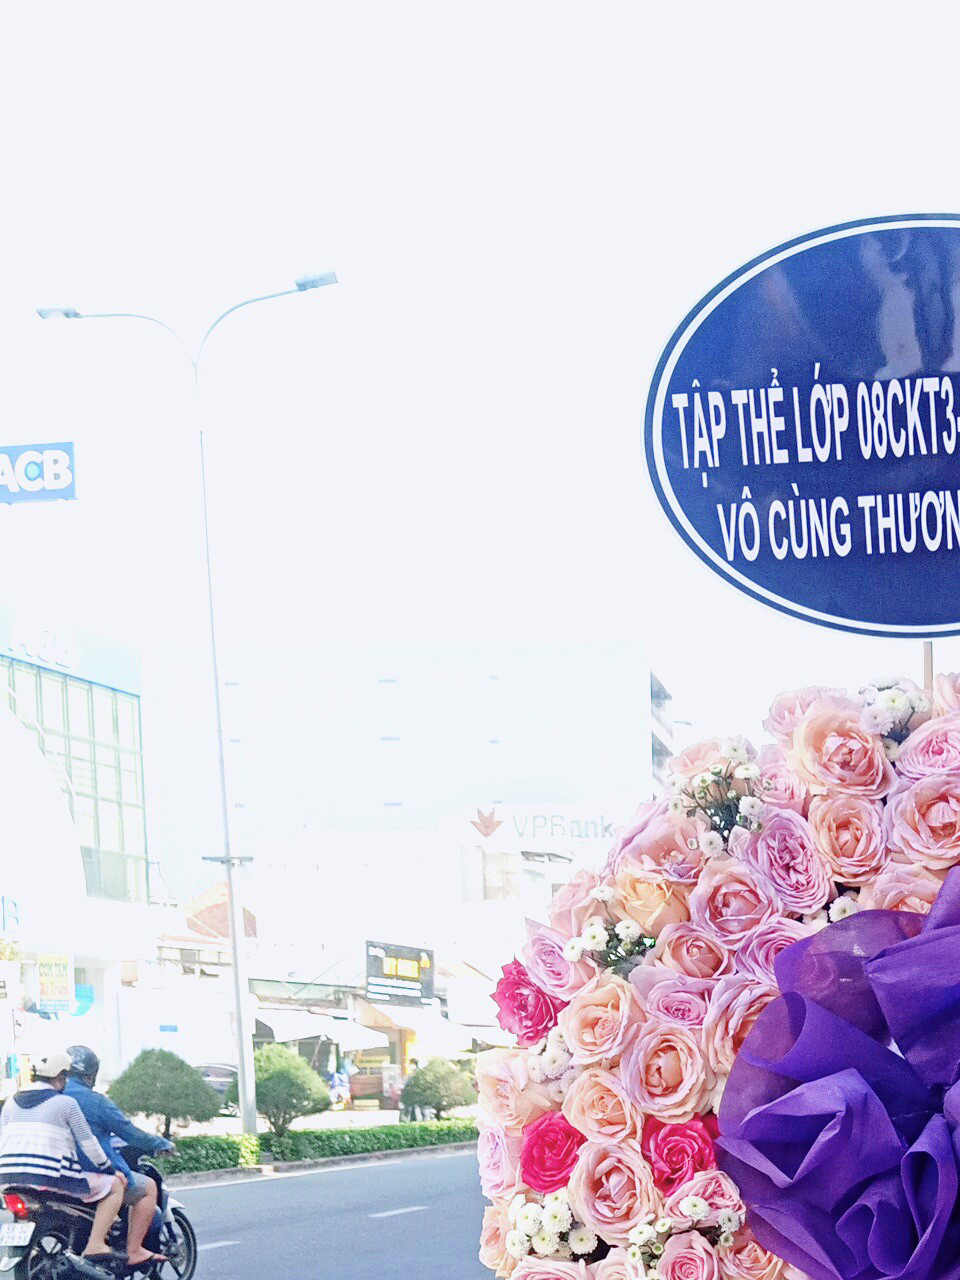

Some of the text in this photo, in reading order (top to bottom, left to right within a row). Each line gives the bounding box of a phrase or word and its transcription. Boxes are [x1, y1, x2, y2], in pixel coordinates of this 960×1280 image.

[671, 380, 727, 488] TẬP
[731, 367, 789, 466] THỂ
[795, 363, 850, 463] LỚP
[0, 449, 73, 493] ACB
[716, 486, 761, 562] VÔ
[768, 483, 853, 561] CÙNG
